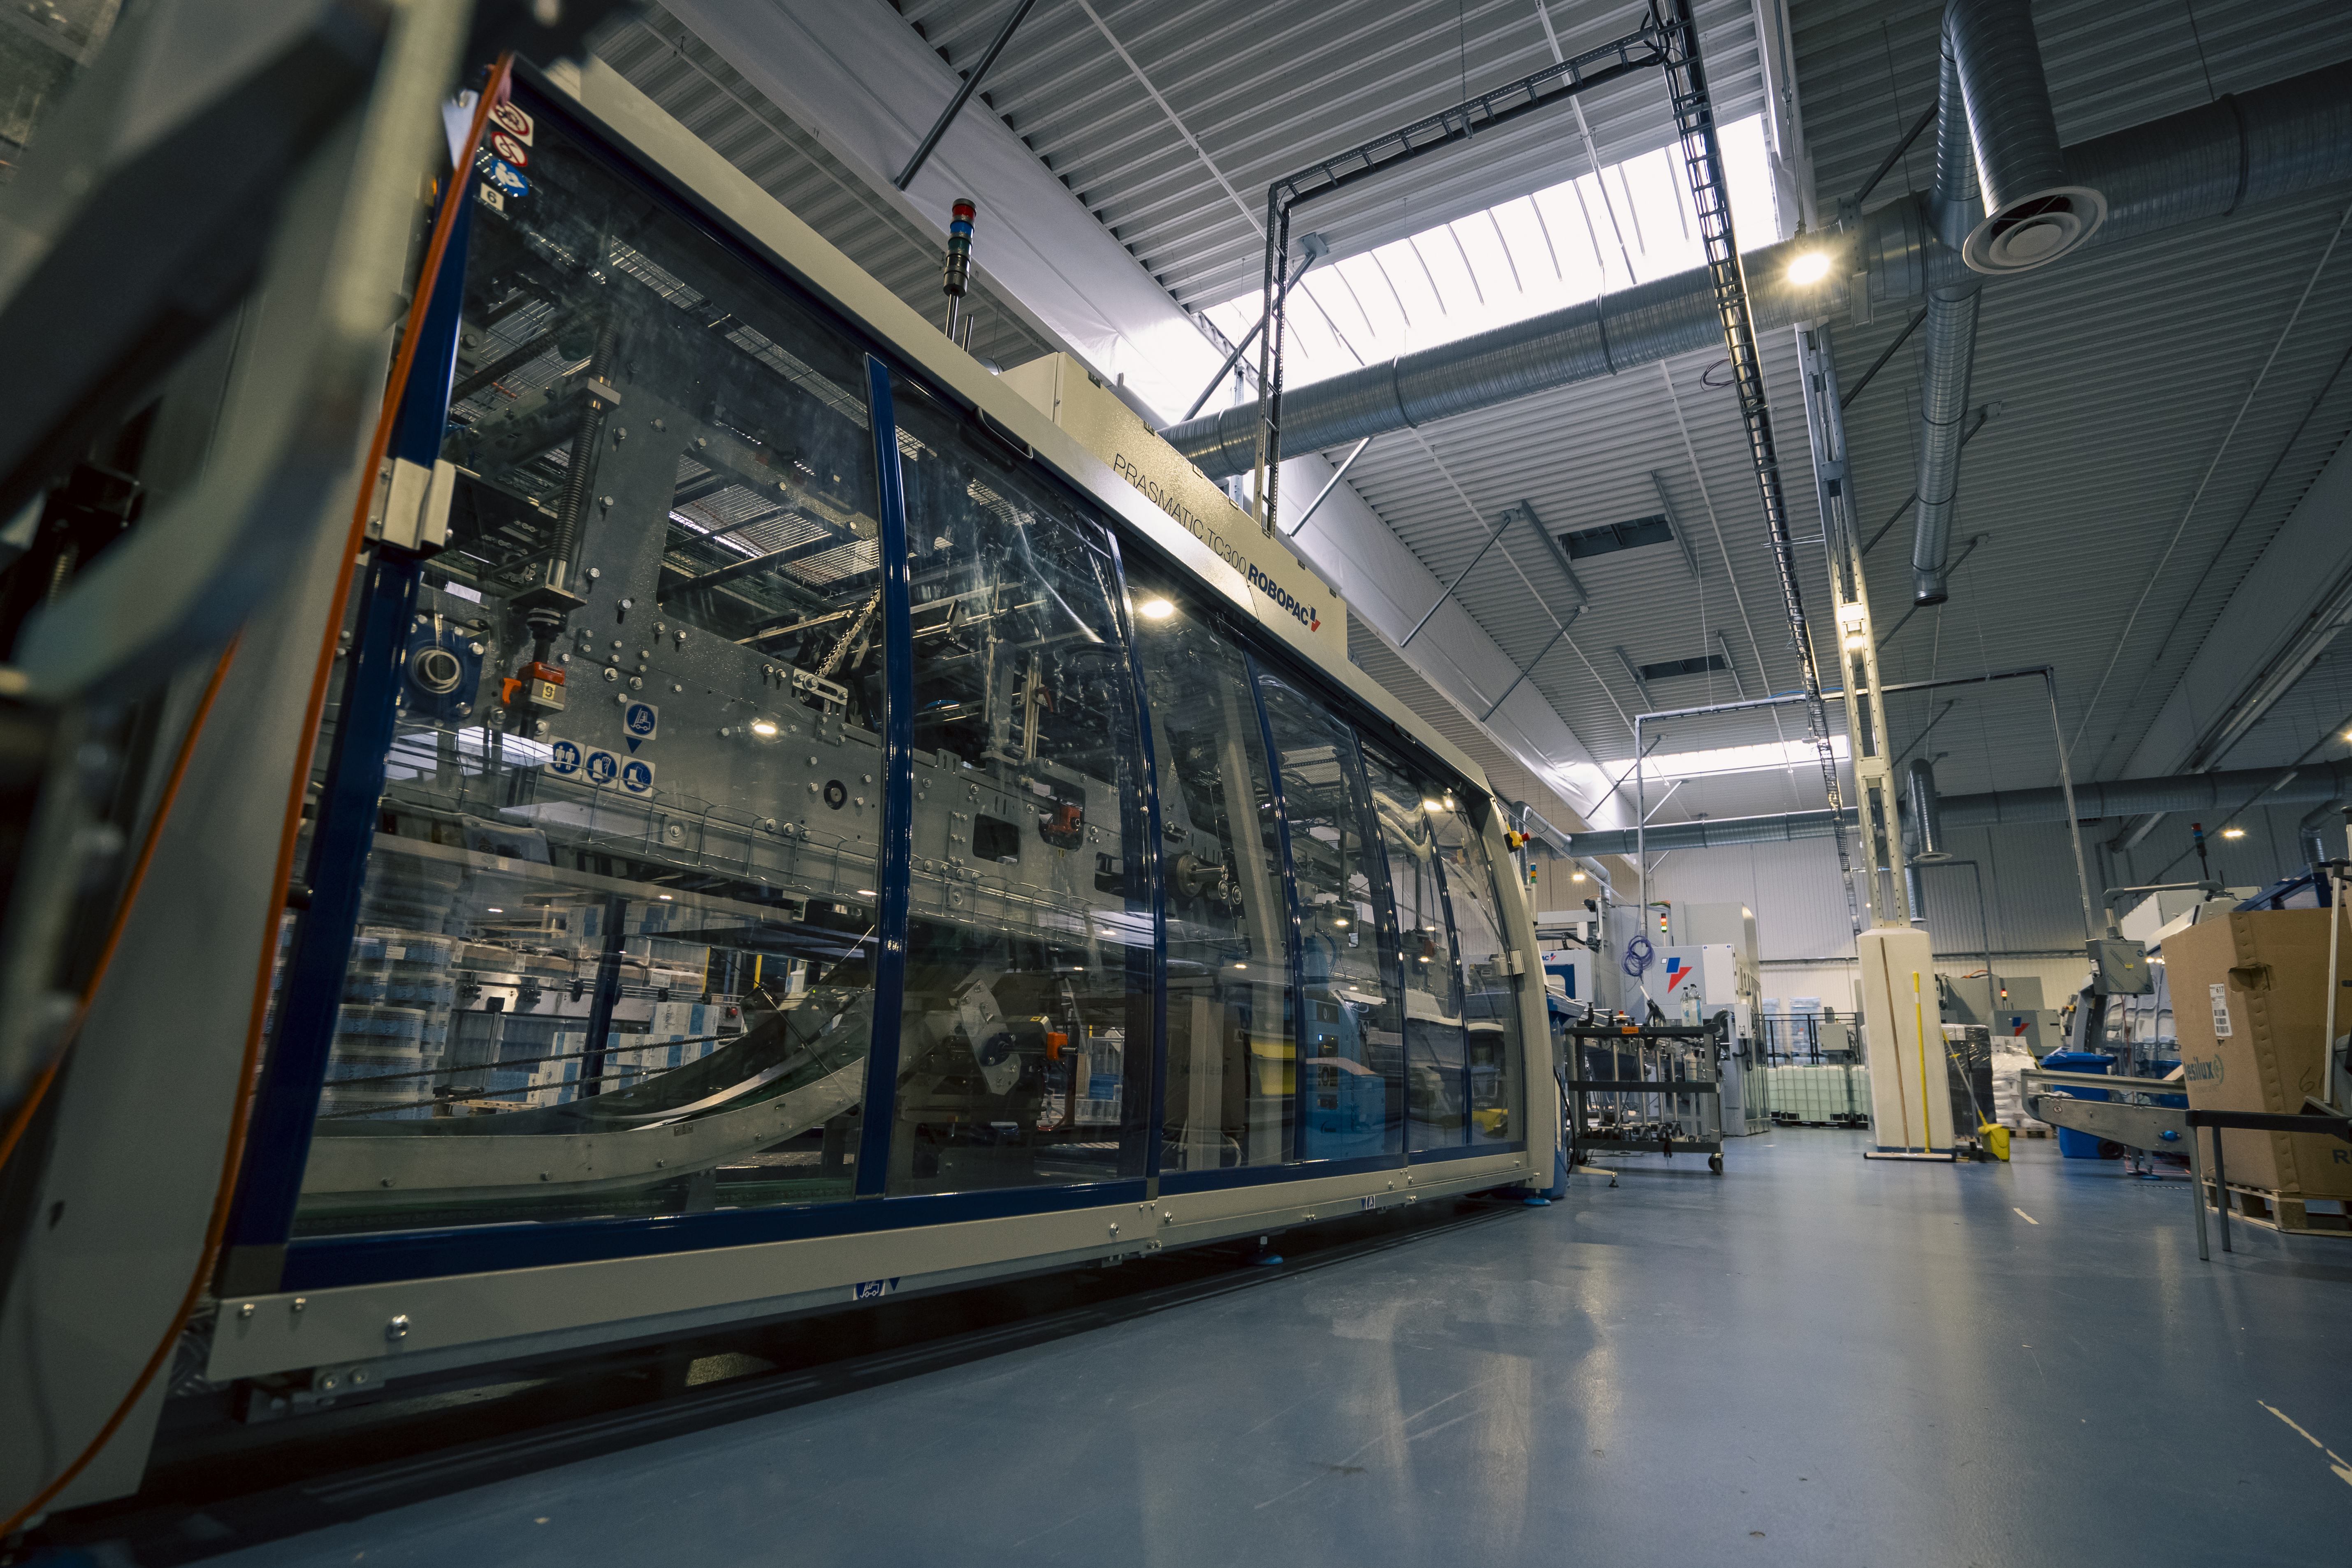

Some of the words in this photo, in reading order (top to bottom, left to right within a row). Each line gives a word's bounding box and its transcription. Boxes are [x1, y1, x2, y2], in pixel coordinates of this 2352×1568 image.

[487, 190, 496, 203] 6
[1113, 453, 1204, 540] PRASMATIC
[1207, 528, 1247, 575] TC300
[1248, 562, 1309, 626] ROBOPAC
[545, 686, 554, 697] 9
[1058, 849, 1065, 857] 10
